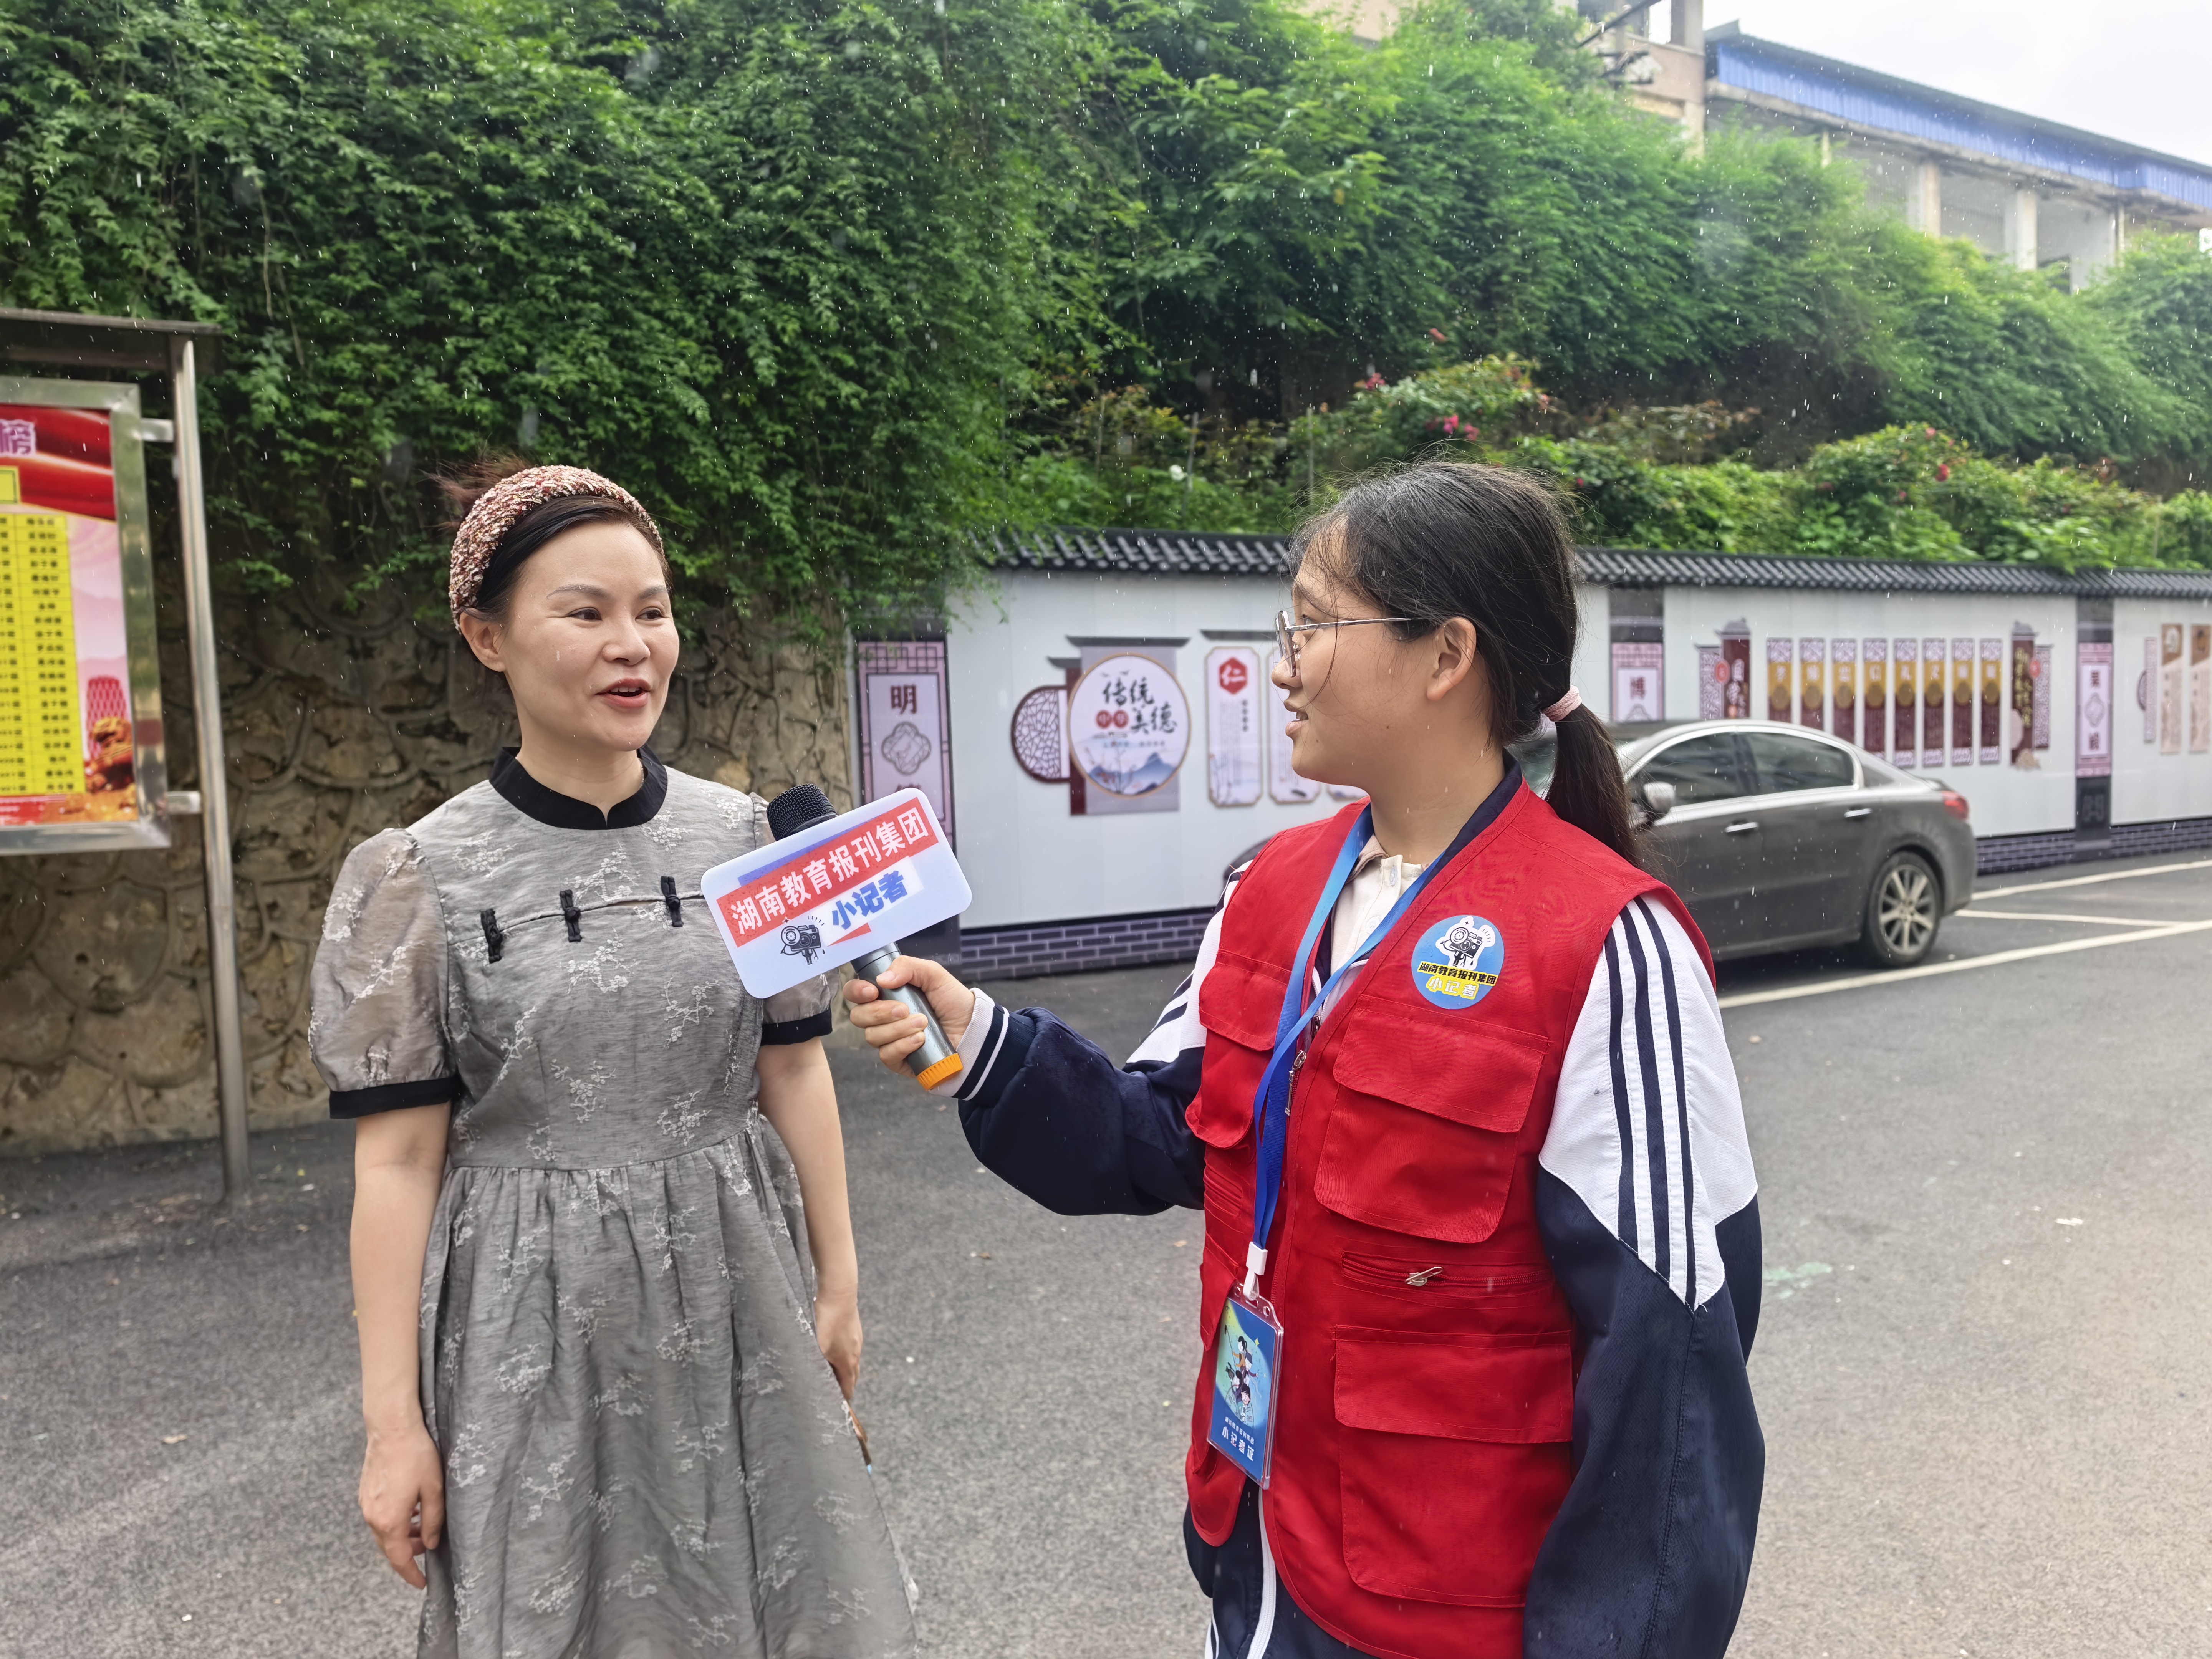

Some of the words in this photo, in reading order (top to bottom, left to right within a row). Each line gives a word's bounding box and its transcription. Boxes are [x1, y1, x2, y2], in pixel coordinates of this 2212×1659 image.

[1221, 665, 1246, 685] 仁
[891, 684, 917, 714] 明
[1103, 677, 1155, 706] 传统
[1131, 701, 1177, 734] 美德
[731, 808, 929, 934] 湖南教育报刊集团
[832, 871, 908, 930] 小记者
[1419, 962, 1497, 985] 湖南教育报刊集团
[1429, 978, 1477, 997] 小记者
[1222, 1426, 1254, 1461] 小记者证
